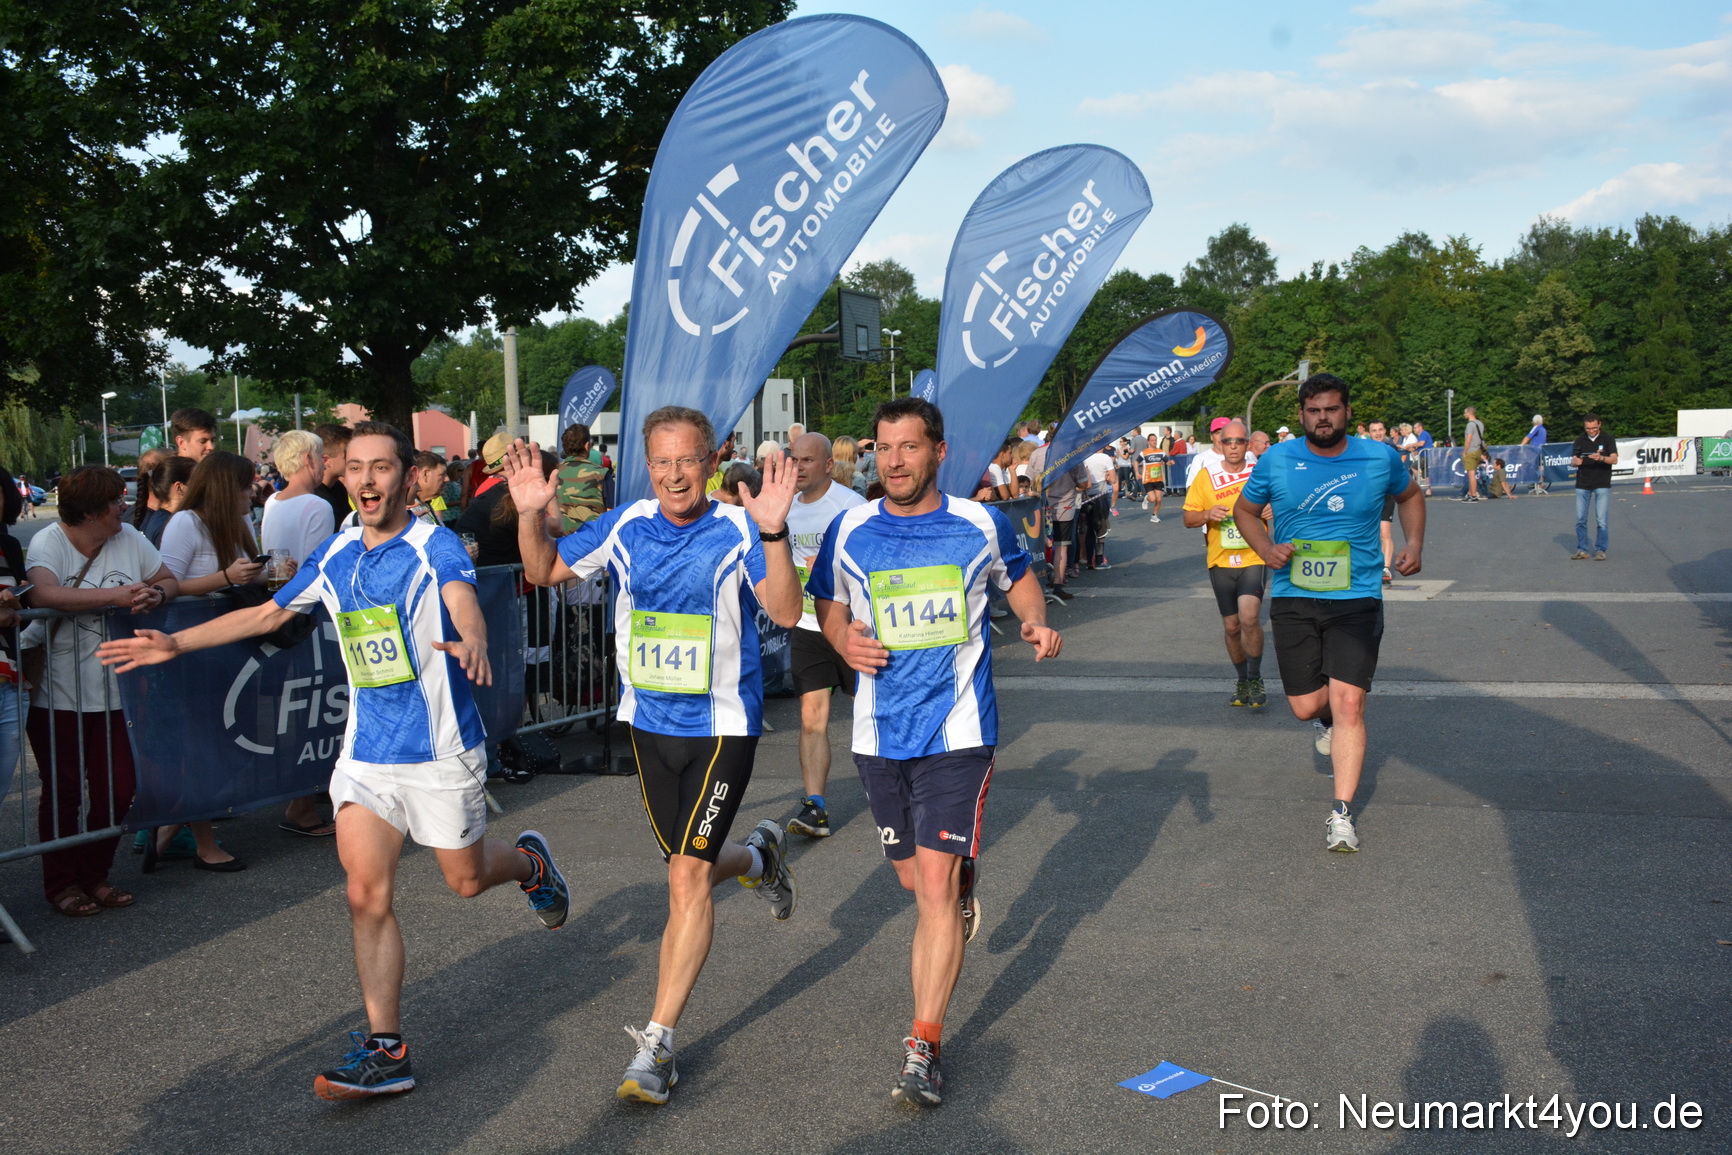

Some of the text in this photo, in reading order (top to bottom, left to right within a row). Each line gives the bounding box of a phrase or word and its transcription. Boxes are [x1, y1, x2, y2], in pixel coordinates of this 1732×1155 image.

[707, 69, 877, 298] Fischer
[767, 112, 896, 295] AUTOMOBILE
[988, 178, 1103, 342] Fischer
[1029, 207, 1117, 338] AUTOMOBILE
[1073, 358, 1185, 430] Frischmann
[1145, 350, 1222, 400] Druck und Medien
[571, 376, 604, 424] Fischer
[582, 385, 608, 424] AUTOMOBILE
[1636, 447, 1672, 464] swn
[1215, 487, 1241, 500] MAX
[1297, 472, 1358, 511] Team Schick Bau
[1302, 560, 1338, 577] 807
[884, 597, 957, 628] 1144
[350, 637, 398, 666] 1139
[637, 642, 697, 671] 1141
[698, 780, 729, 838] SKINS
